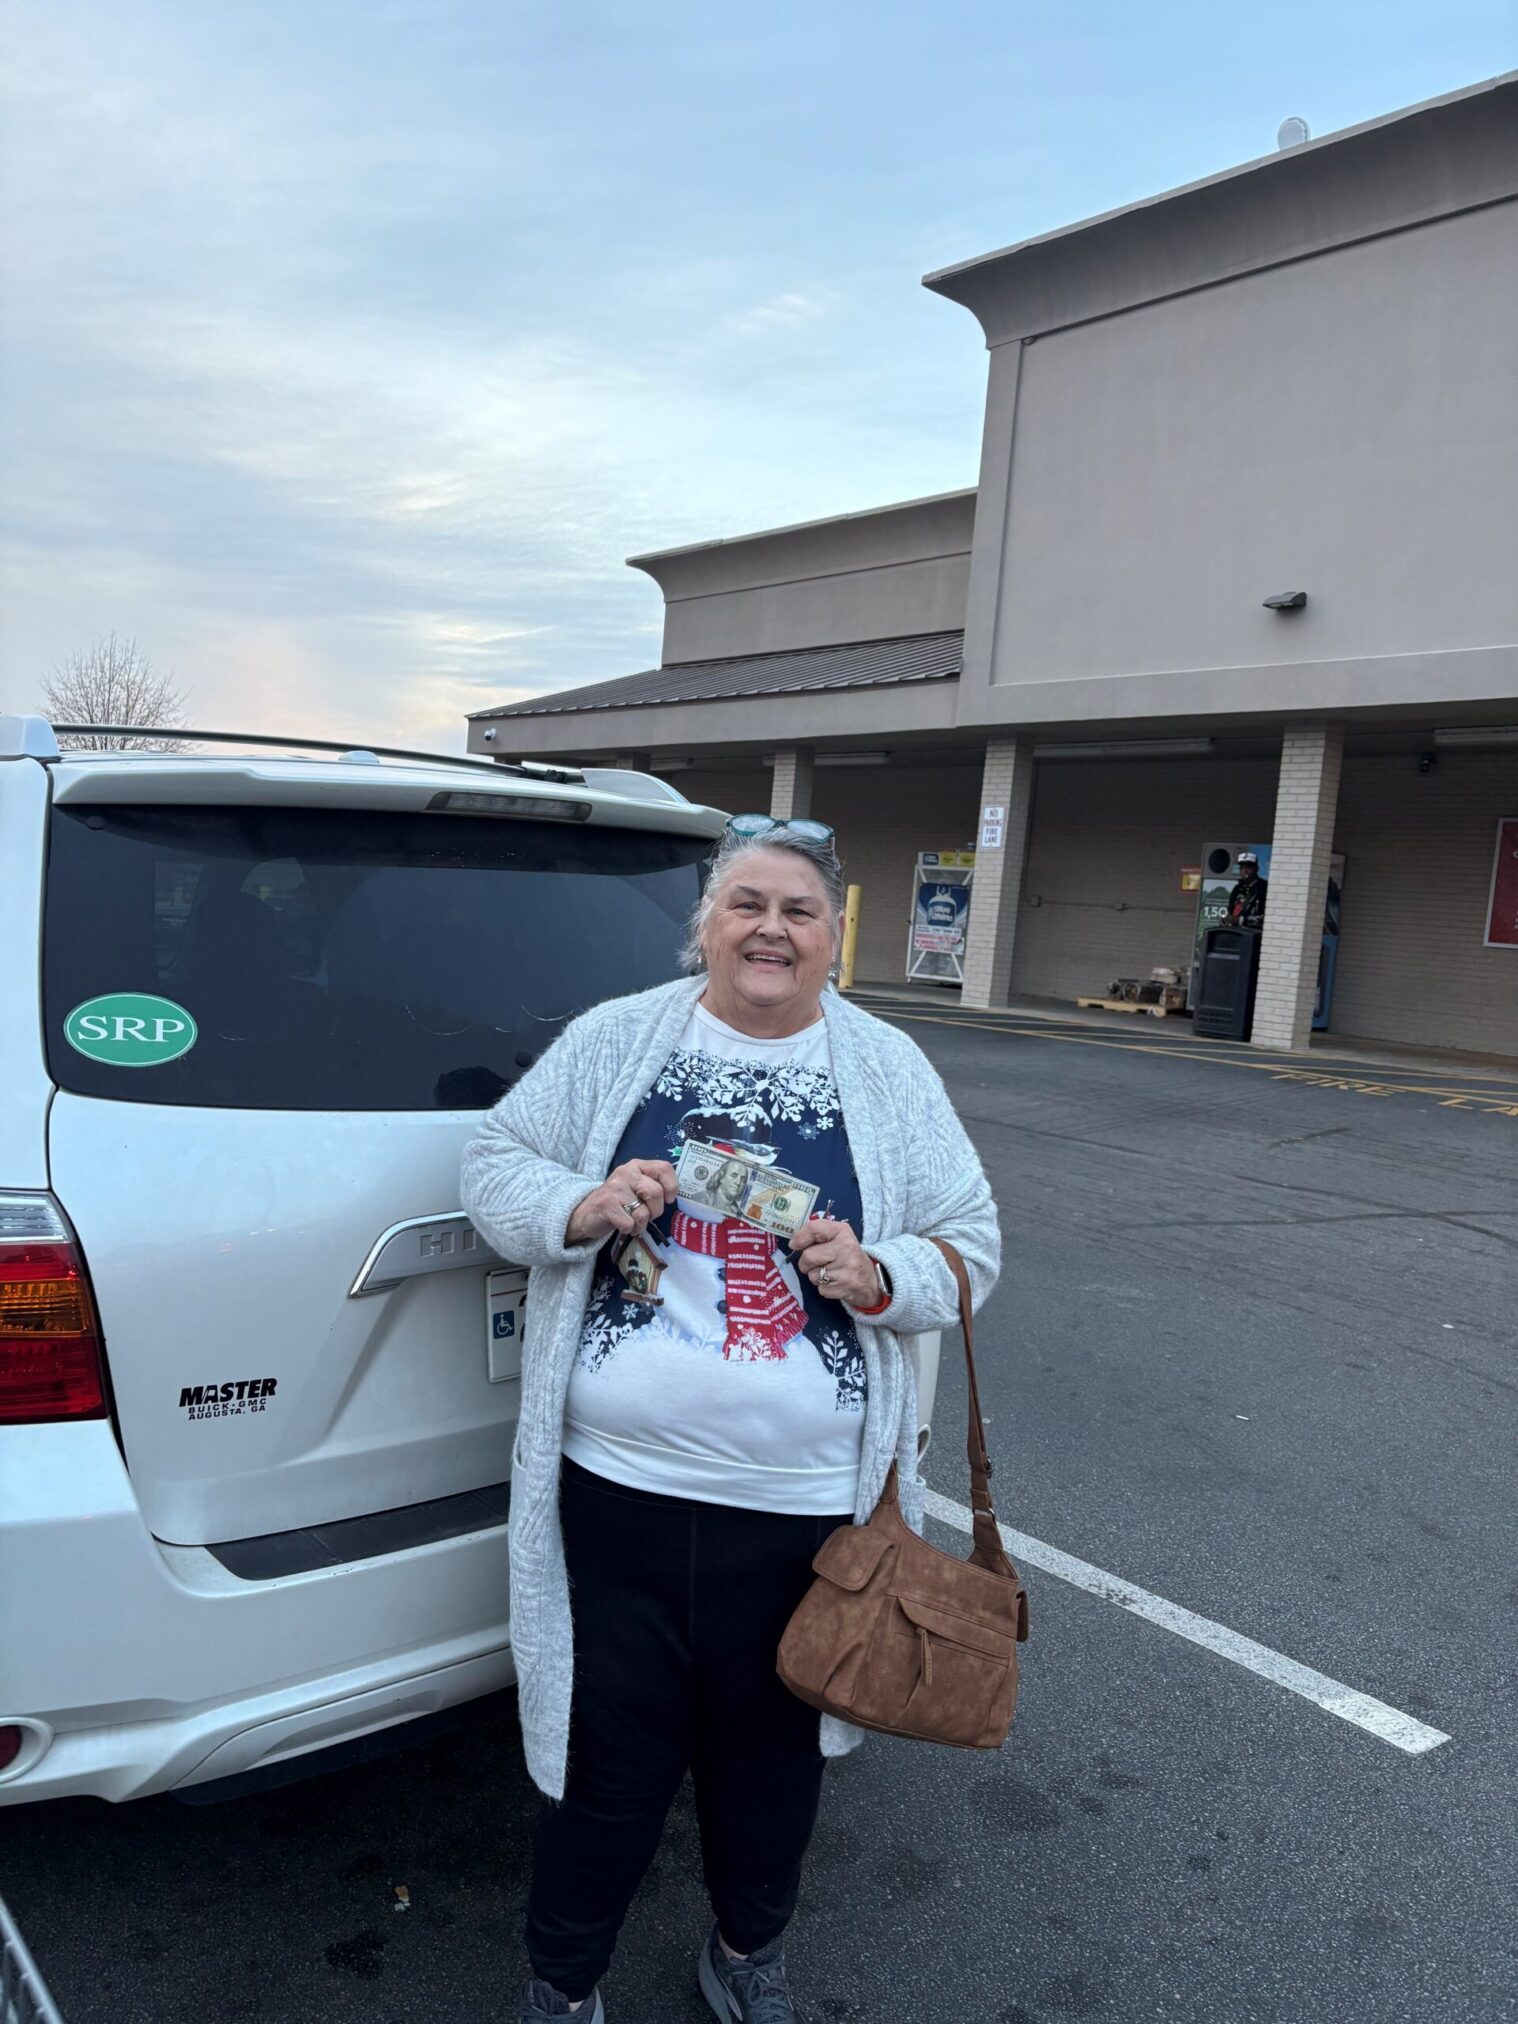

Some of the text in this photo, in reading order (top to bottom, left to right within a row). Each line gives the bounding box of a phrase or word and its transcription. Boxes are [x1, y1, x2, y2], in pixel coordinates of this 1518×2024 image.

[989, 808, 999, 818] NO
[986, 827, 999, 836] FIRE
[984, 836, 999, 844] LANE
[77, 1015, 185, 1042] SRP
[1270, 1073, 1406, 1097] FIRE
[179, 1378, 278, 1407] MASTER
[251, 1404, 266, 1413] GA
